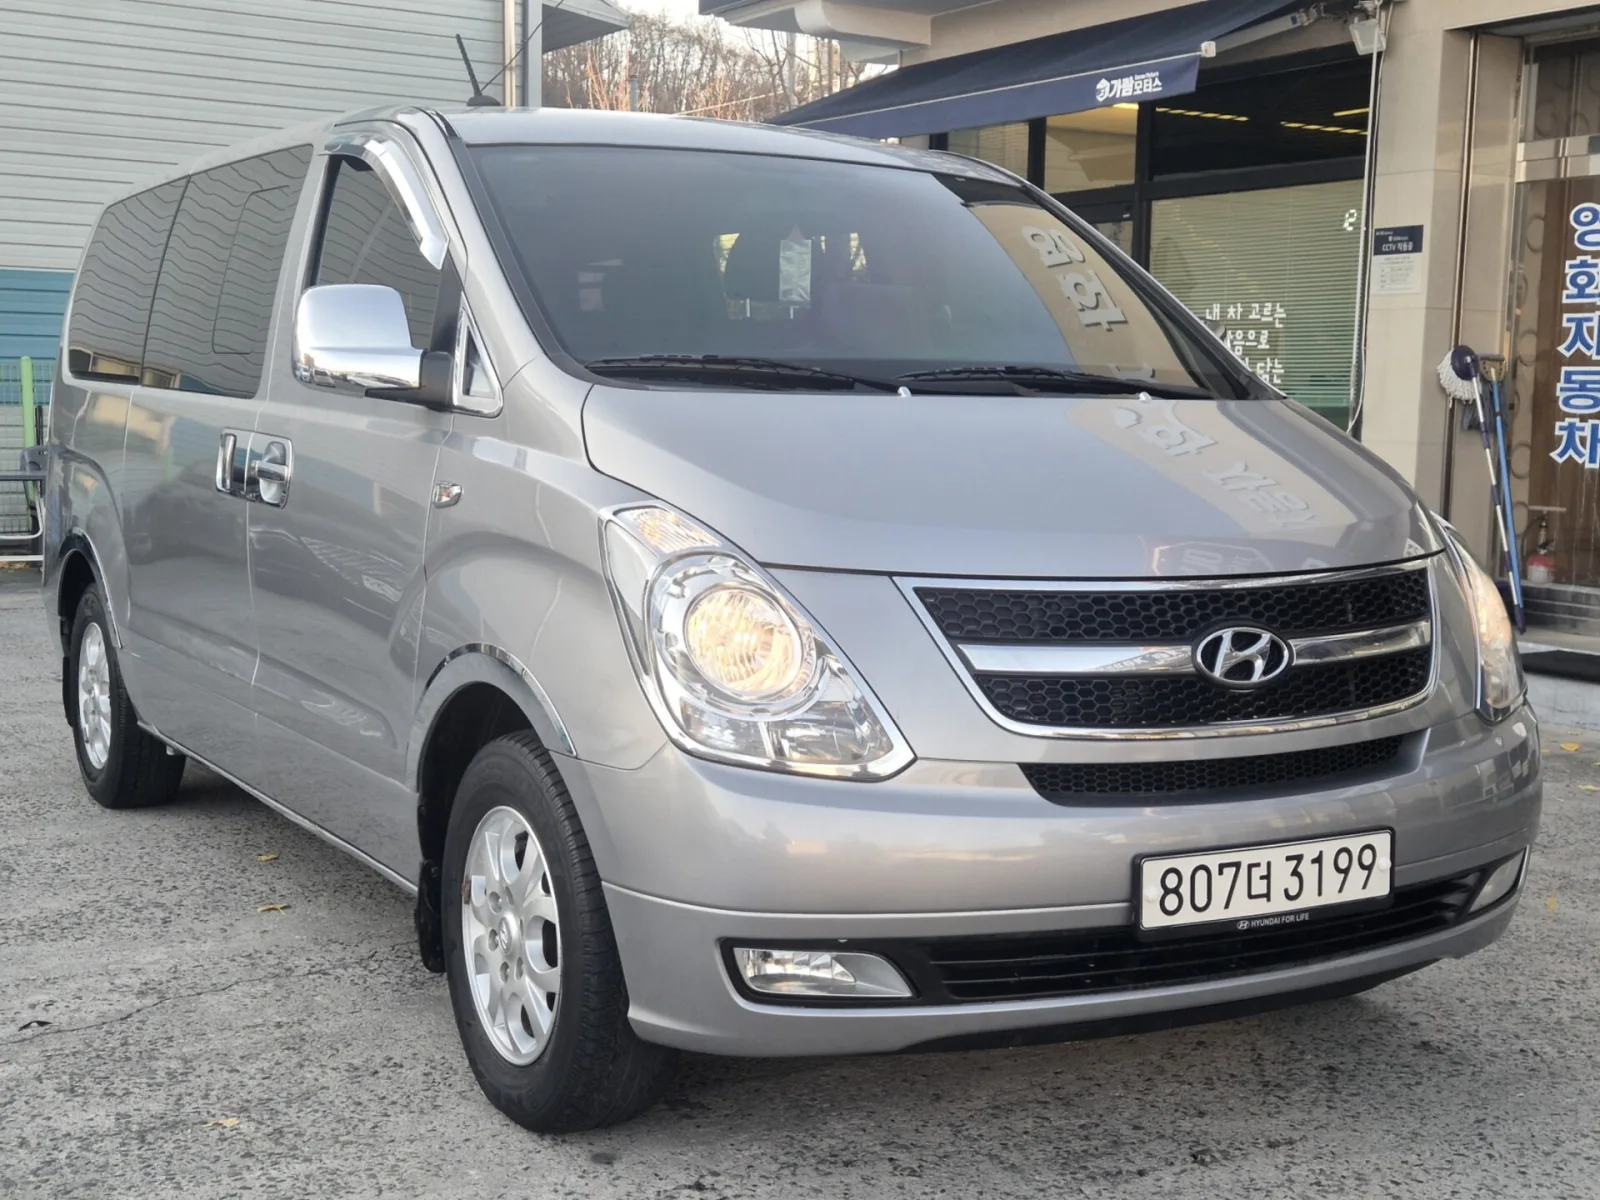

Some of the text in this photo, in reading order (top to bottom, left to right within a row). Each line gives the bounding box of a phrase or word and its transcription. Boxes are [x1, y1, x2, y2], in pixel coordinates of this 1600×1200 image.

[1108, 76, 1163, 98] 가람모터스
[1382, 243, 1396, 252] CCTV
[1205, 302, 1286, 328] 내 차 고르는
[1250, 912, 1310, 928] HYUNDAI FOR LIFE
